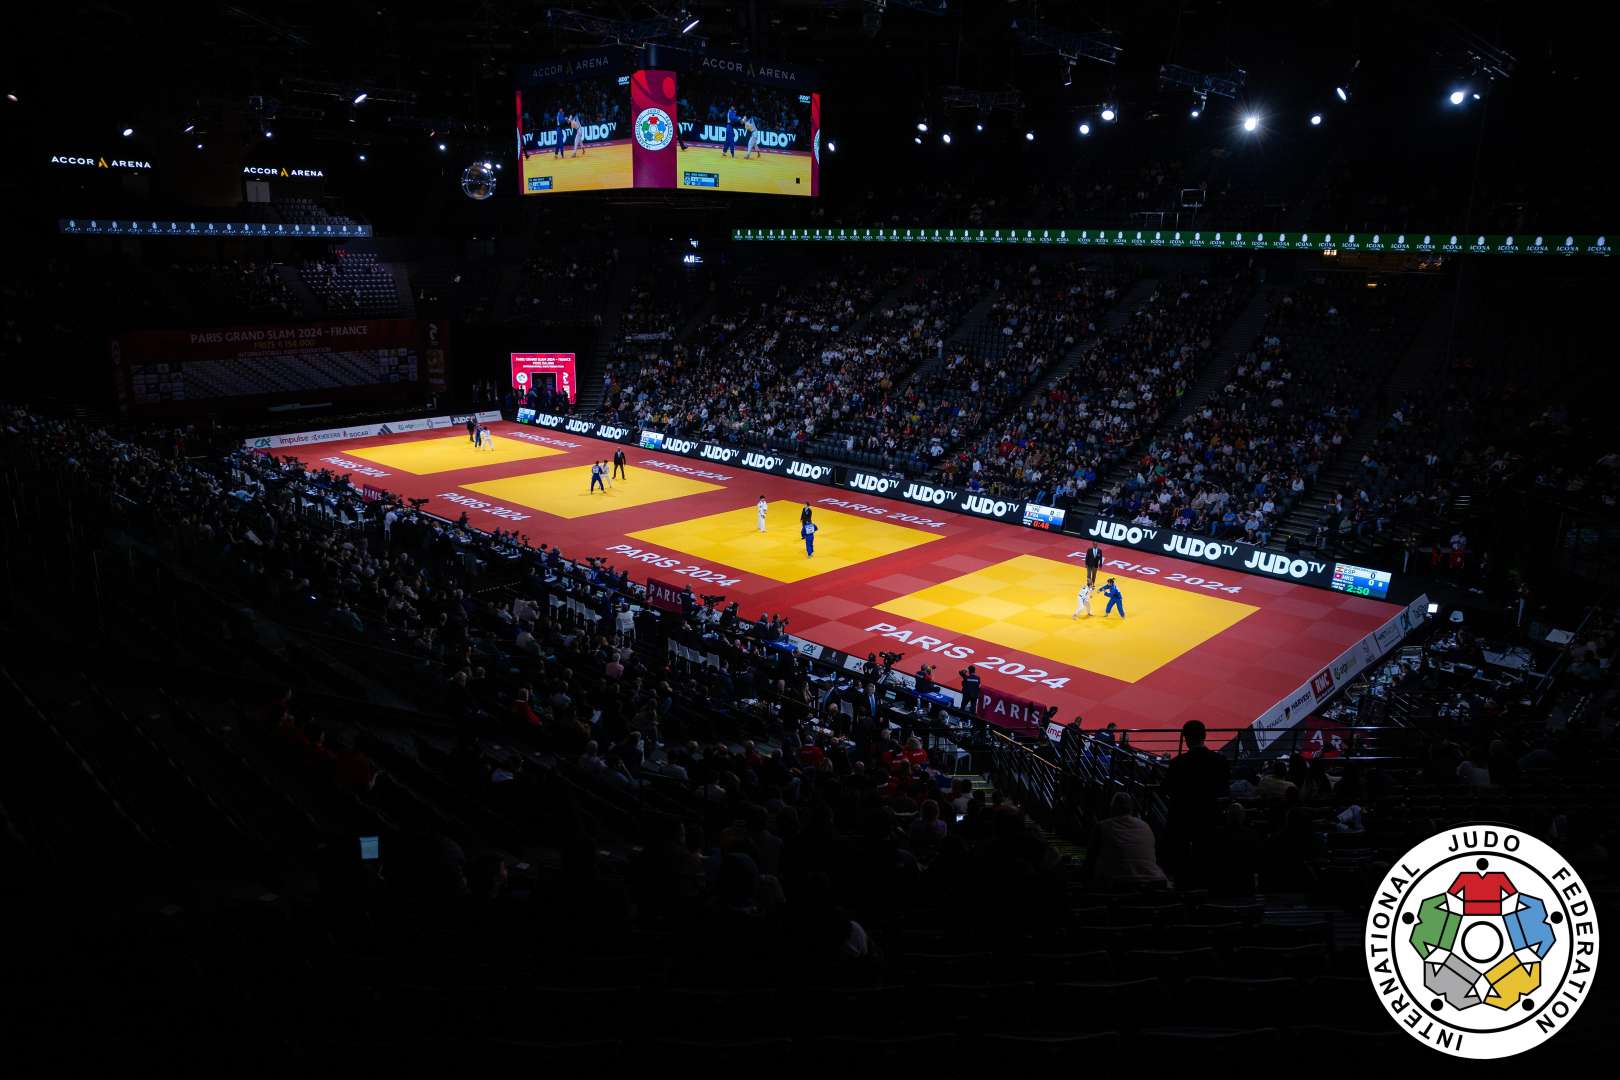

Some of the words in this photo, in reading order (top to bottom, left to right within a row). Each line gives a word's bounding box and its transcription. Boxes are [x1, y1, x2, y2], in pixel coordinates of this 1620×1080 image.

[576, 56, 609, 70] ARENA
[703, 57, 743, 72] ACCOR
[759, 66, 796, 81] ARENA
[51, 155, 95, 166] ACCOR
[111, 160, 152, 169] ARENA
[243, 166, 278, 175] ACCOR
[291, 168, 324, 177] ARENA
[190, 333, 224, 344] PARIS
[224, 330, 266, 342] GRAND
[266, 329, 298, 340] SLAM
[298, 327, 322, 338] 2024
[328, 325, 369, 336] FRANCE
[280, 435, 308, 444] impulse
[436, 492, 491, 509] PARIS
[482, 507, 532, 521] 2024
[816, 498, 888, 515] PARIS
[886, 512, 946, 528] 2024
[605, 544, 681, 568] PARIS
[673, 565, 742, 587] 2024
[1066, 551, 1161, 575] PRIS
[1164, 573, 1242, 594] 2024
[649, 583, 682, 605] PARIS
[1346, 584, 1369, 596] 2:50
[864, 622, 975, 660] PARIS
[974, 656, 1071, 689] 2024
[1314, 672, 1330, 694] RMC
[982, 694, 1040, 725] PARIS
[1291, 691, 1312, 710] HARVEST
